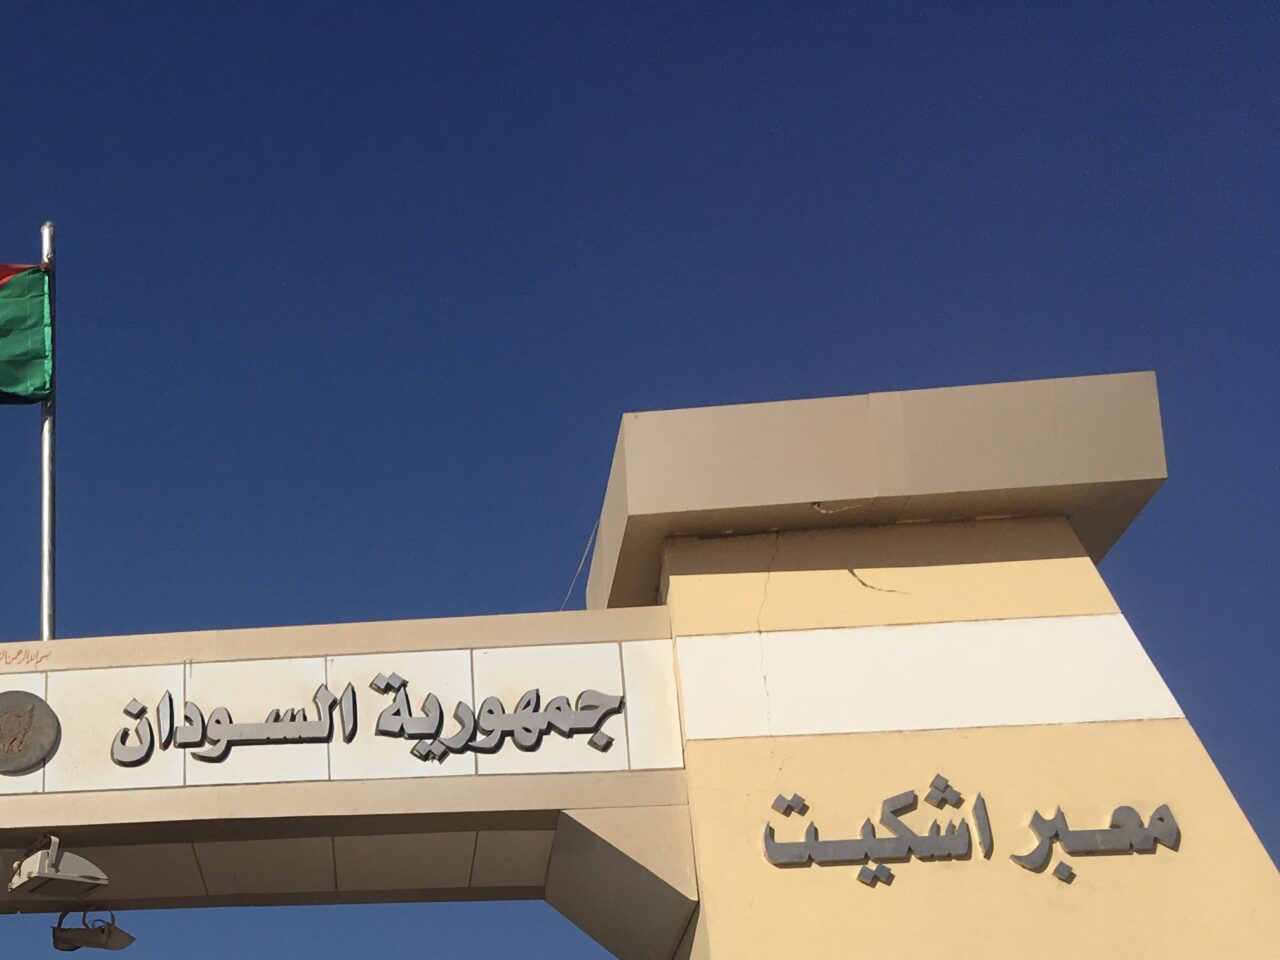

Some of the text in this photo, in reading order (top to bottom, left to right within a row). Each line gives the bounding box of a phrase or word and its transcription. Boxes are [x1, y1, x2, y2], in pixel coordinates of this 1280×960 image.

[110, 672, 625, 768] جمهورية السودان
[1009, 803, 1182, 885] معبر
